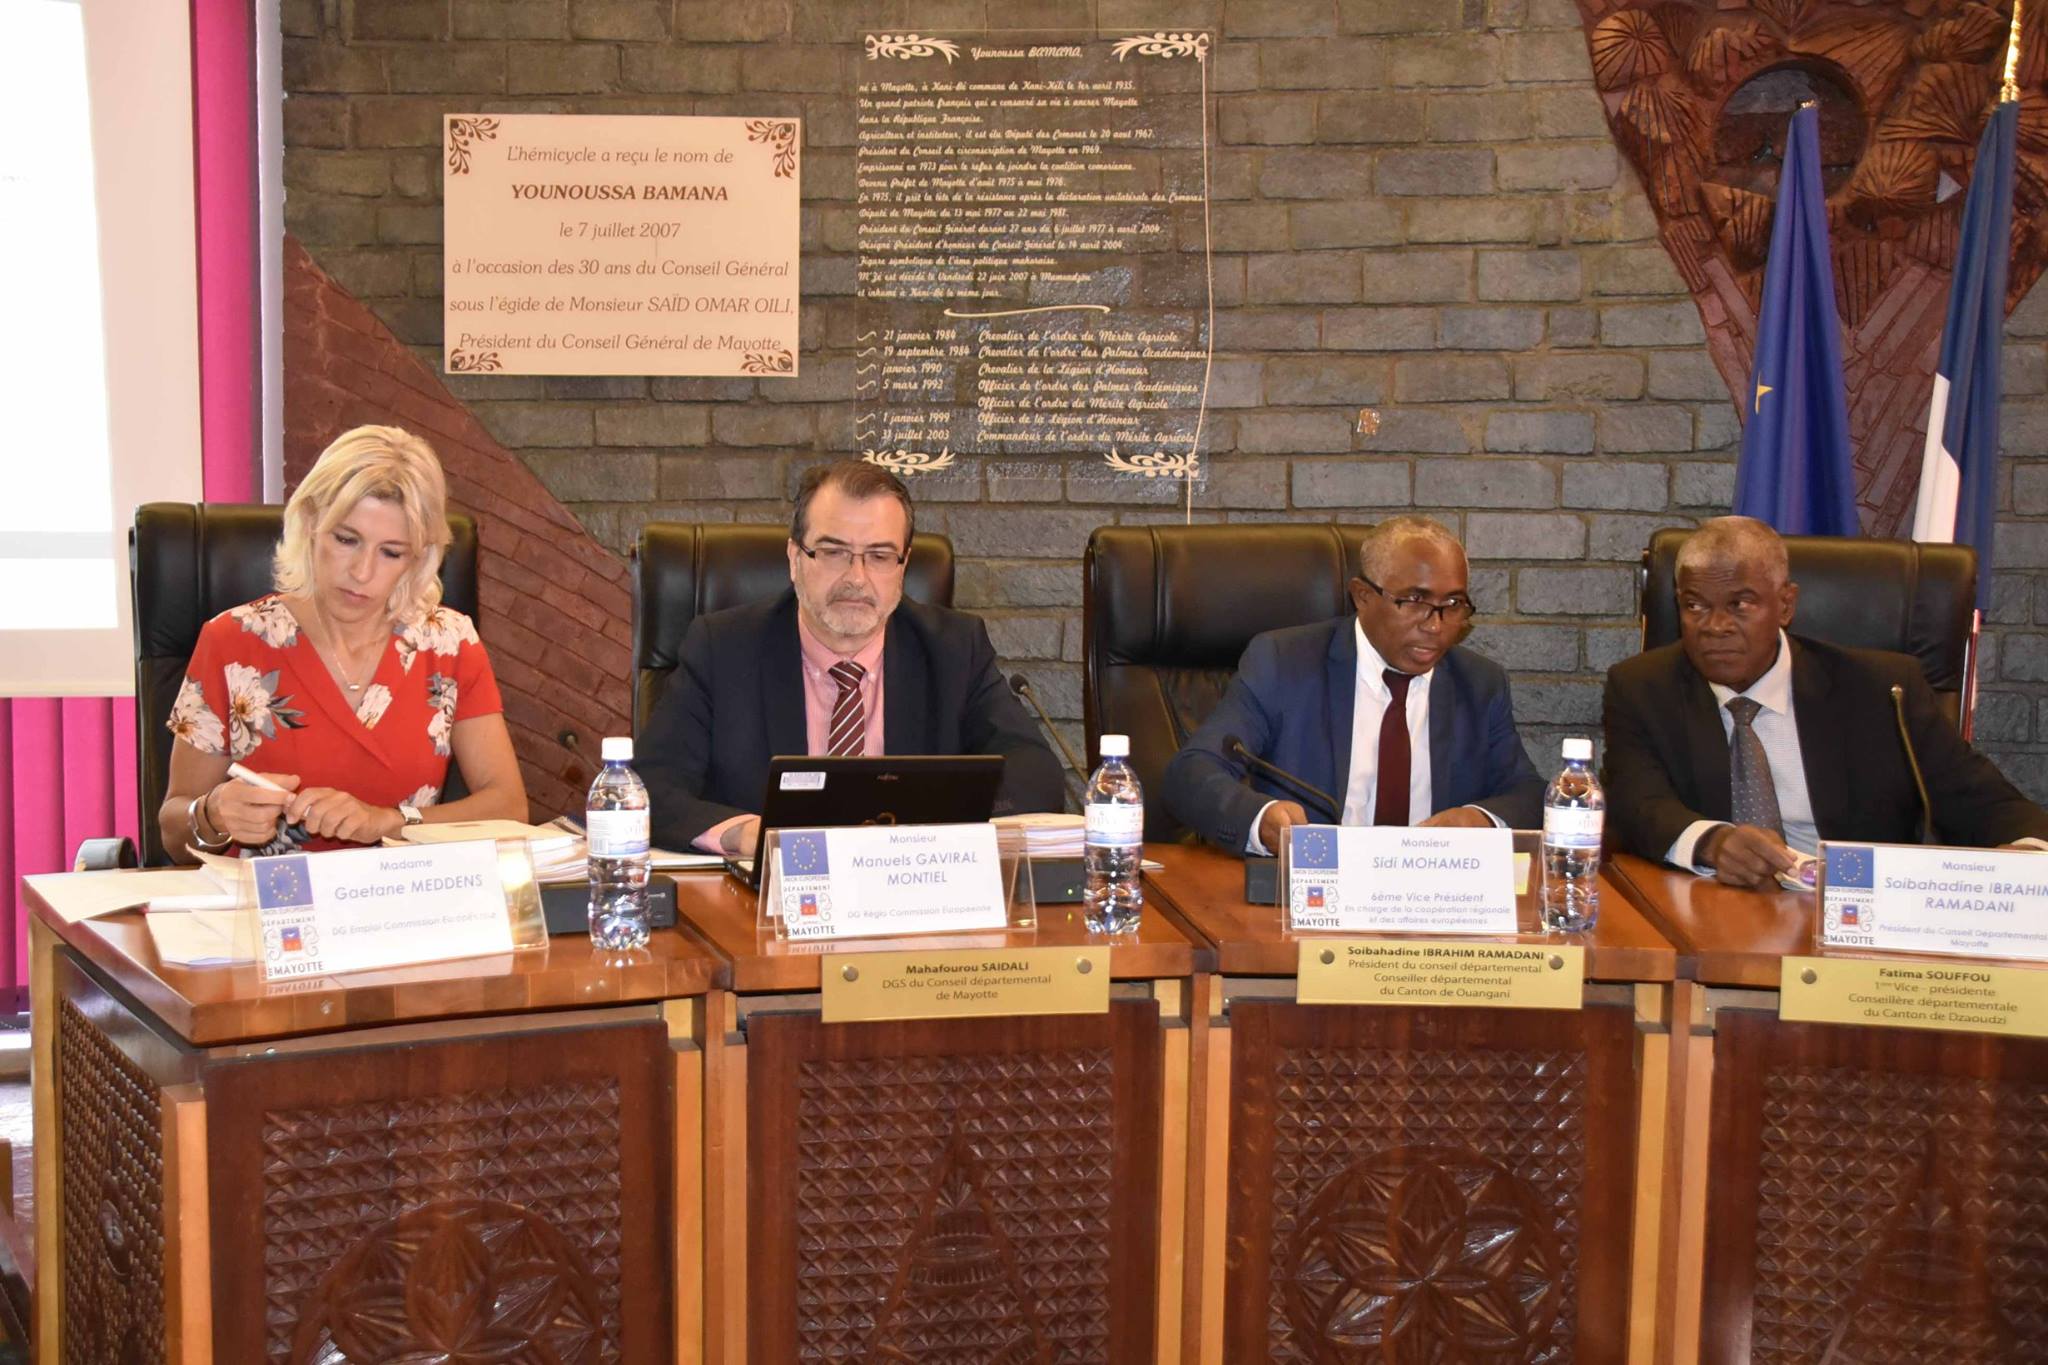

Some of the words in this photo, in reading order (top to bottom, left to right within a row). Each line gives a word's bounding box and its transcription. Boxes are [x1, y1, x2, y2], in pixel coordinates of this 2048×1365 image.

[970, 47, 1025, 61] Younoussa
[507, 146, 596, 165] L'hémicycle
[601, 151, 610, 162] a
[616, 151, 648, 166] reçu
[655, 148, 668, 162] le
[673, 152, 709, 162] nom
[714, 148, 734, 163] de
[512, 184, 636, 200] YOUNOUSSA
[643, 185, 728, 201] BAMANA
[559, 222, 573, 237] le
[578, 222, 588, 237] 7
[591, 222, 635, 240] juillet
[640, 222, 681, 238] 2007
[452, 260, 461, 274] à
[466, 258, 542, 274] l'occasion
[547, 259, 574, 274] des
[579, 259, 600, 275] 30
[605, 263, 631, 274] ans
[636, 260, 656, 275] du
[661, 260, 721, 275] Conseil
[726, 260, 789, 276] Général
[450, 300, 484, 312] sous
[489, 296, 541, 314] l'égide
[545, 297, 565, 312] de
[569, 296, 643, 312] Monsieur
[648, 293, 690, 312] SAÏD
[695, 297, 749, 313] OMAR
[460, 333, 531, 349] Président
[536, 334, 556, 349] du
[562, 333, 620, 349] Conseil
[626, 334, 688, 350] Général
[693, 335, 712, 350] de
[717, 335, 781, 352] Mayotte
[889, 834, 937, 844] Monsieur
[1401, 838, 1450, 848] Monsieur
[380, 859, 433, 871] Madame
[852, 854, 911, 868] Manuels
[916, 851, 977, 865] GAVIRAL
[1372, 856, 1398, 869] Sidi
[1401, 857, 1480, 870] MOHAMED
[1942, 861, 1996, 873] Monsieur
[888, 871, 947, 886] MONTIEL
[1884, 877, 1984, 893] Soibahadine
[334, 884, 406, 901] Gaetane
[411, 874, 483, 893] MEDDENS
[1406, 892, 1431, 902] Vice
[1434, 892, 1484, 903] Président
[889, 907, 940, 917] Commission
[1357, 905, 1388, 914] charge
[1390, 905, 1402, 913] de
[1404, 905, 1412, 913] la
[1925, 897, 2015, 913] RAMADANI
[1296, 918, 1341, 927] MAYOTTE
[1380, 916, 1395, 924] des
[791, 925, 836, 937] MAYOTTE
[1939, 927, 1973, 937] Conseil
[1830, 935, 1875, 945] MAYOTTE
[1347, 946, 1420, 957] Soibahadine
[1423, 948, 1475, 958] IBRAHIM
[1478, 950, 1544, 960] RAMADANI
[273, 961, 323, 975] MAYOTTE
[905, 963, 978, 975] Mahafourou
[981, 962, 1029, 972] SAIDALI
[1348, 960, 1399, 969] Président
[1402, 960, 1416, 970] du
[1419, 961, 1457, 971] conseil
[1460, 962, 1542, 975] départemental
[882, 979, 907, 989] DGS
[910, 978, 924, 988] du
[927, 976, 968, 988] Conseil
[970, 974, 1051, 989] départemental
[1374, 972, 1427, 983] Conseiller
[1430, 974, 1512, 987] départemental
[1879, 968, 1923, 980] Fatima
[1926, 970, 1991, 983] SOUFFOU
[935, 990, 949, 1001] de
[952, 989, 999, 1003] Mayotte
[1379, 986, 1394, 996] du
[1397, 987, 1437, 997] Canton
[1440, 988, 1453, 997] de
[1456, 988, 1510, 1000] Ouangani
[1894, 982, 1919, 993] Vice
[1929, 984, 1997, 998] présidente
[1848, 993, 1915, 1006] Conseillère
[1917, 996, 2018, 1013] départementale
[1864, 1008, 1880, 1018] du
[1882, 1008, 1927, 1020] Canton
[1929, 1011, 1945, 1021] de
[1948, 1012, 2007, 1025] Dzaoudzi
